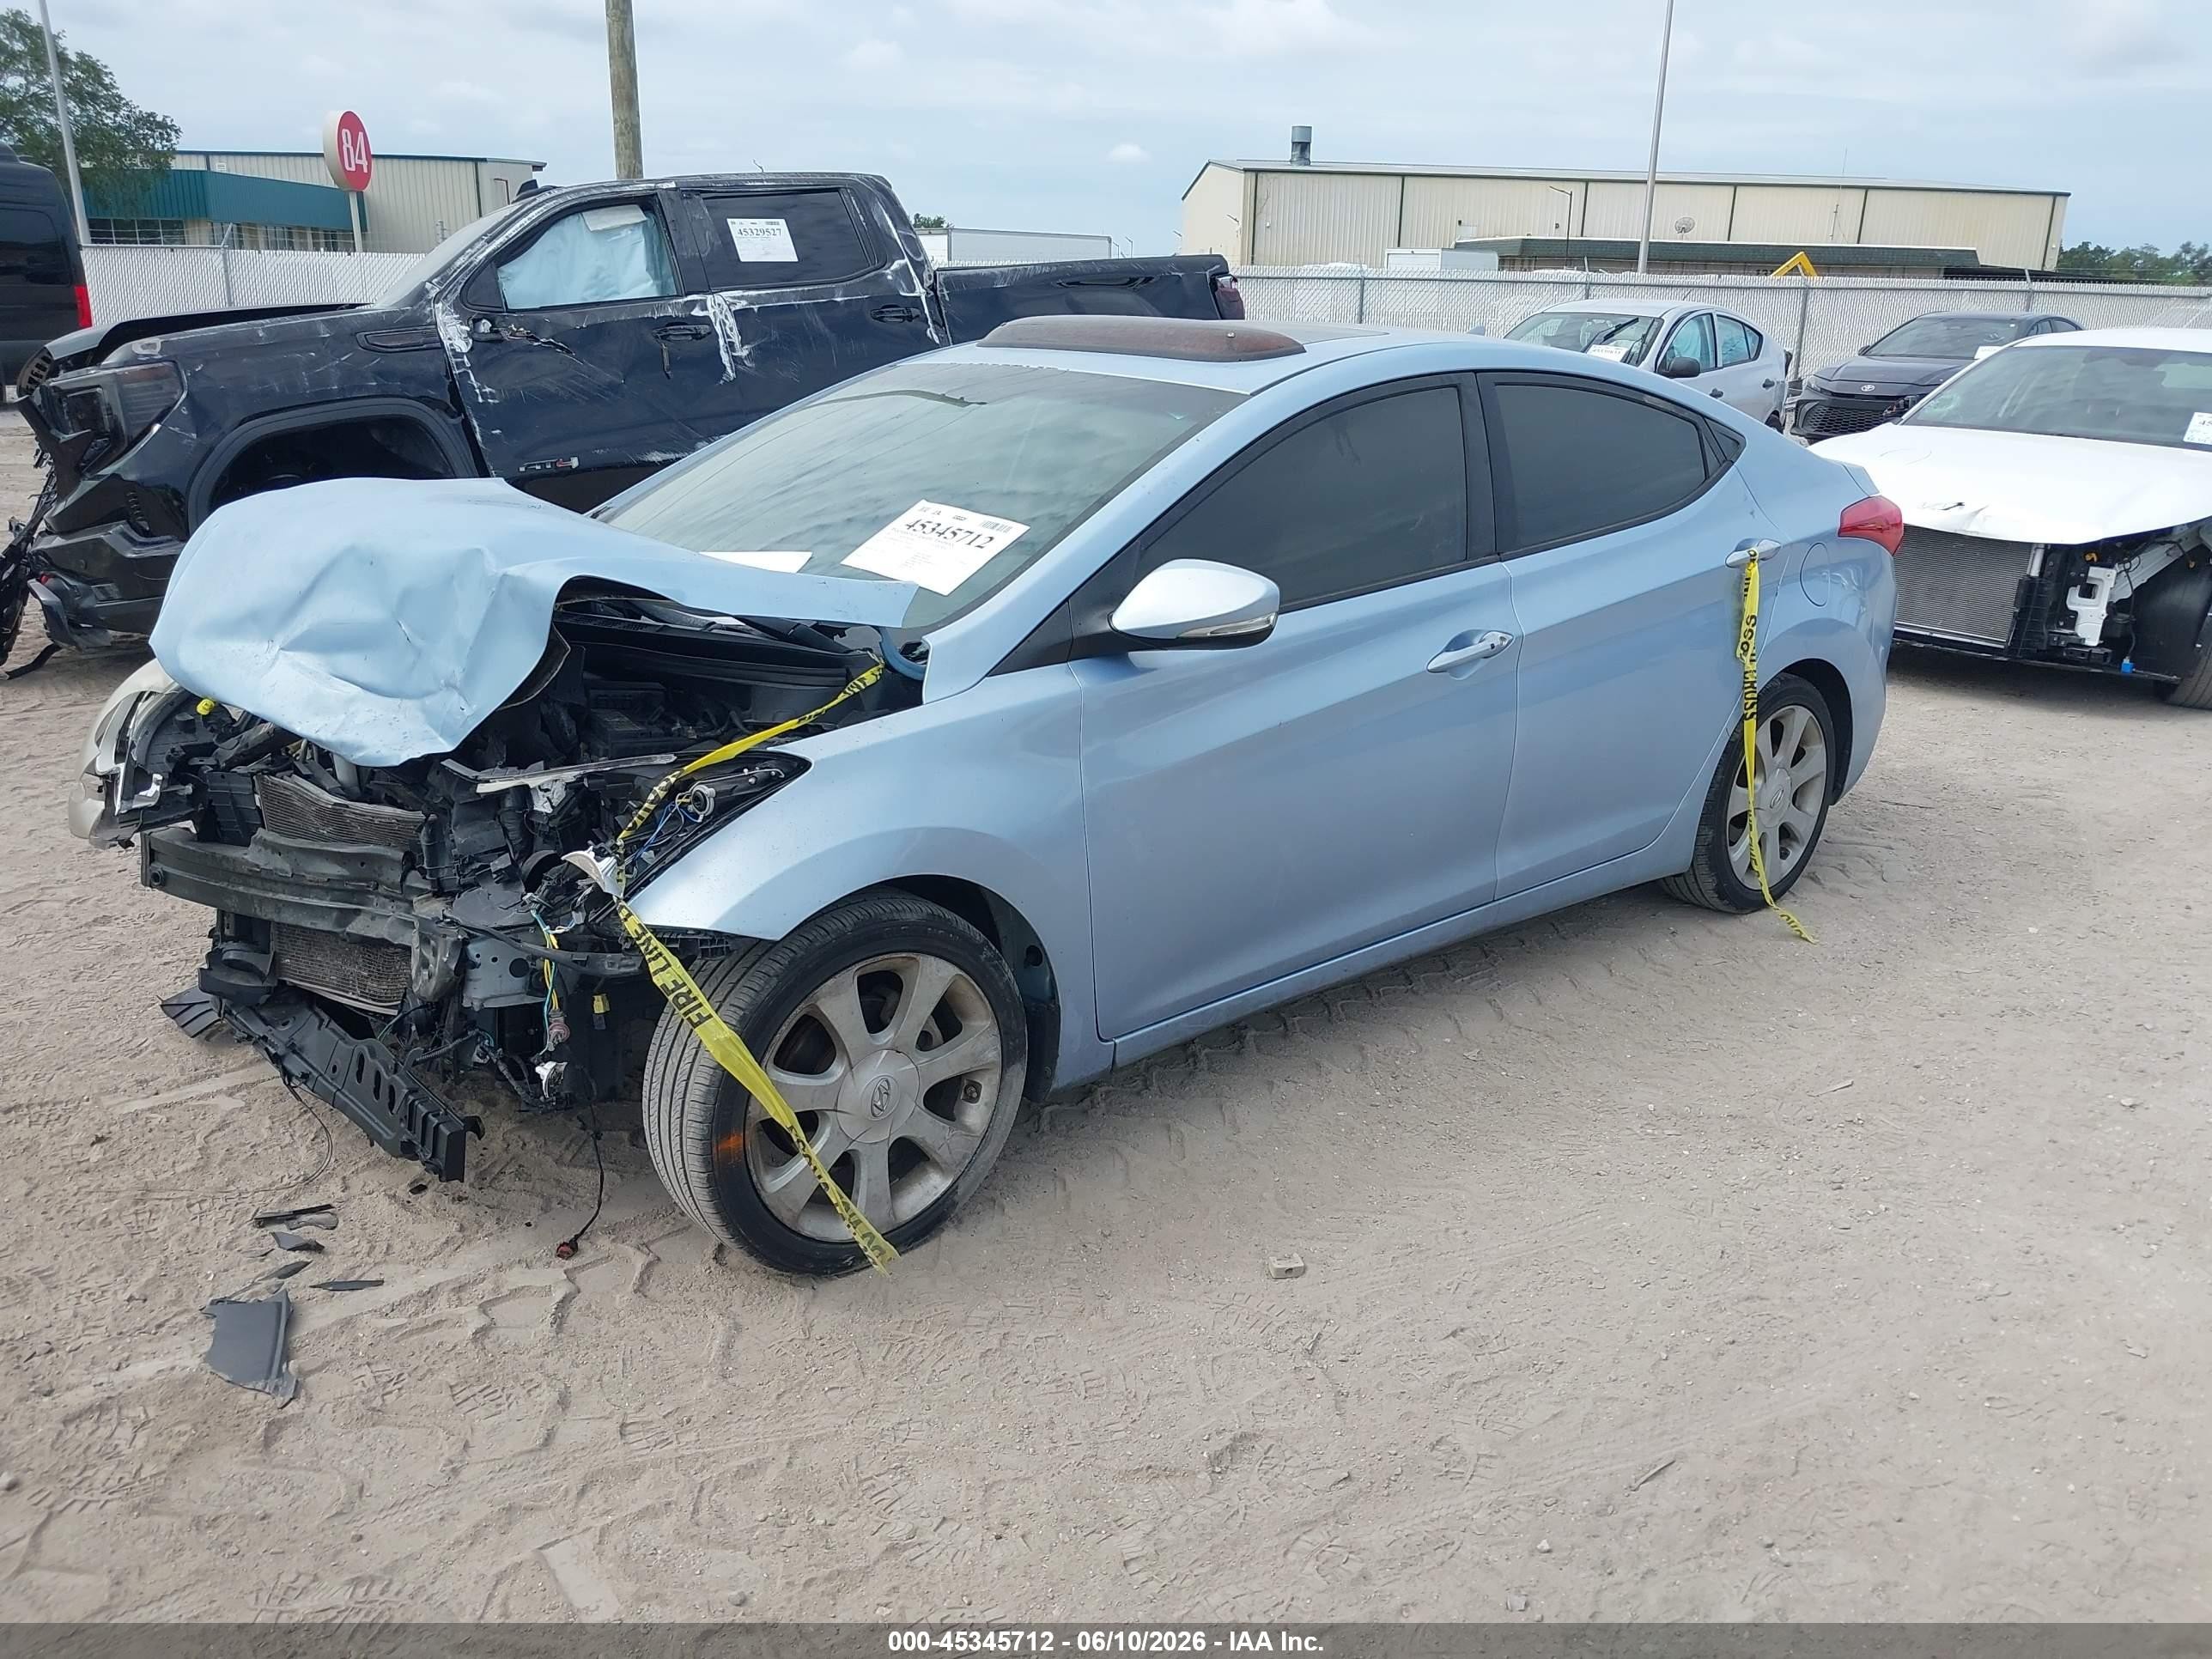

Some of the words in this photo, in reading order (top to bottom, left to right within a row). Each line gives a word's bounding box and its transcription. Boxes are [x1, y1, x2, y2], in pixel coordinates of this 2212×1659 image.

[342, 128, 368, 173] 84
[738, 228, 781, 236] 45329527
[906, 518, 994, 550] 45345712
[634, 922, 672, 977] LINE
